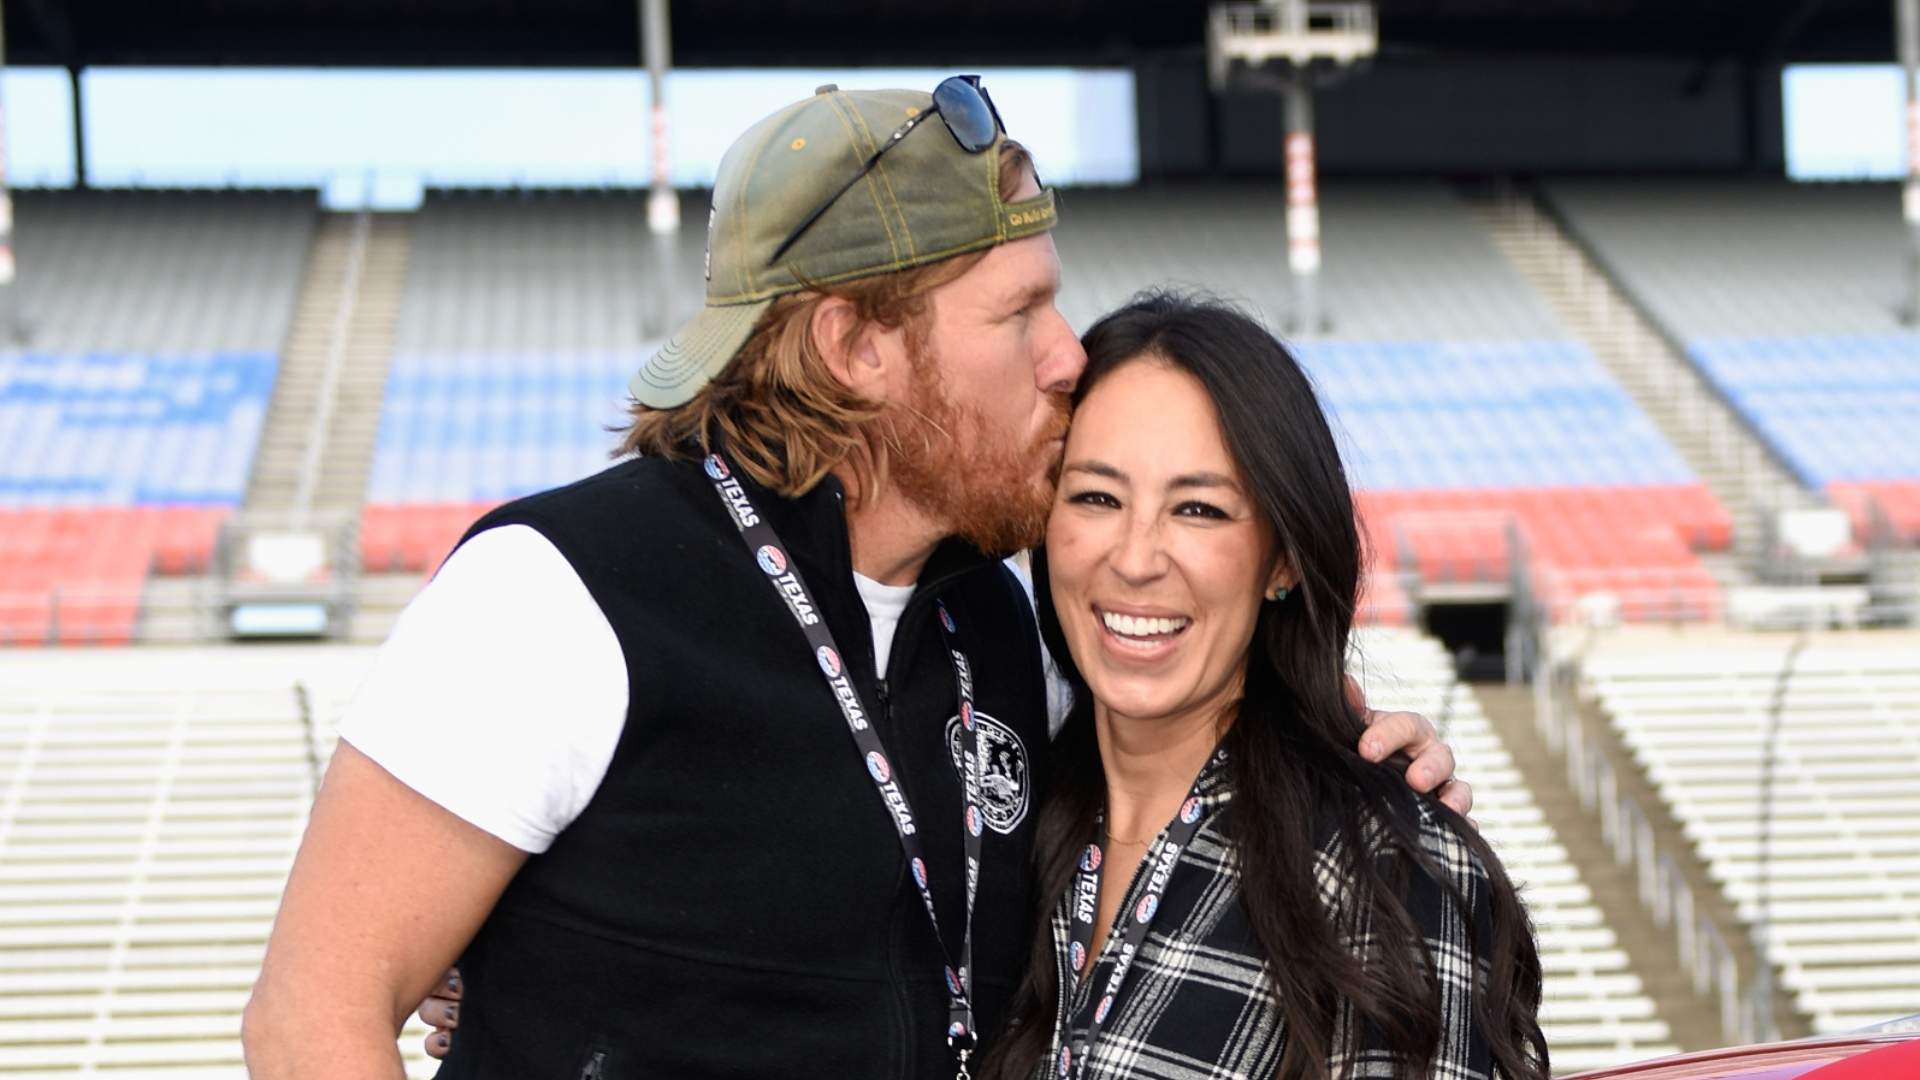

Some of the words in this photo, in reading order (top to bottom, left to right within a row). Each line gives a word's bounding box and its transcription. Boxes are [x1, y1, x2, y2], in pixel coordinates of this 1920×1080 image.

[721, 476, 760, 528] TEXAS
[778, 571, 819, 626] TEXAS
[952, 648, 970, 700] TEXAS
[834, 675, 869, 731] TEXAS
[964, 750, 979, 803] TEXAS
[883, 780, 916, 836] TEXAS
[1147, 841, 1178, 894] TEXAS
[1077, 872, 1098, 925] TEXAS
[1105, 942, 1134, 994] TEXAS
